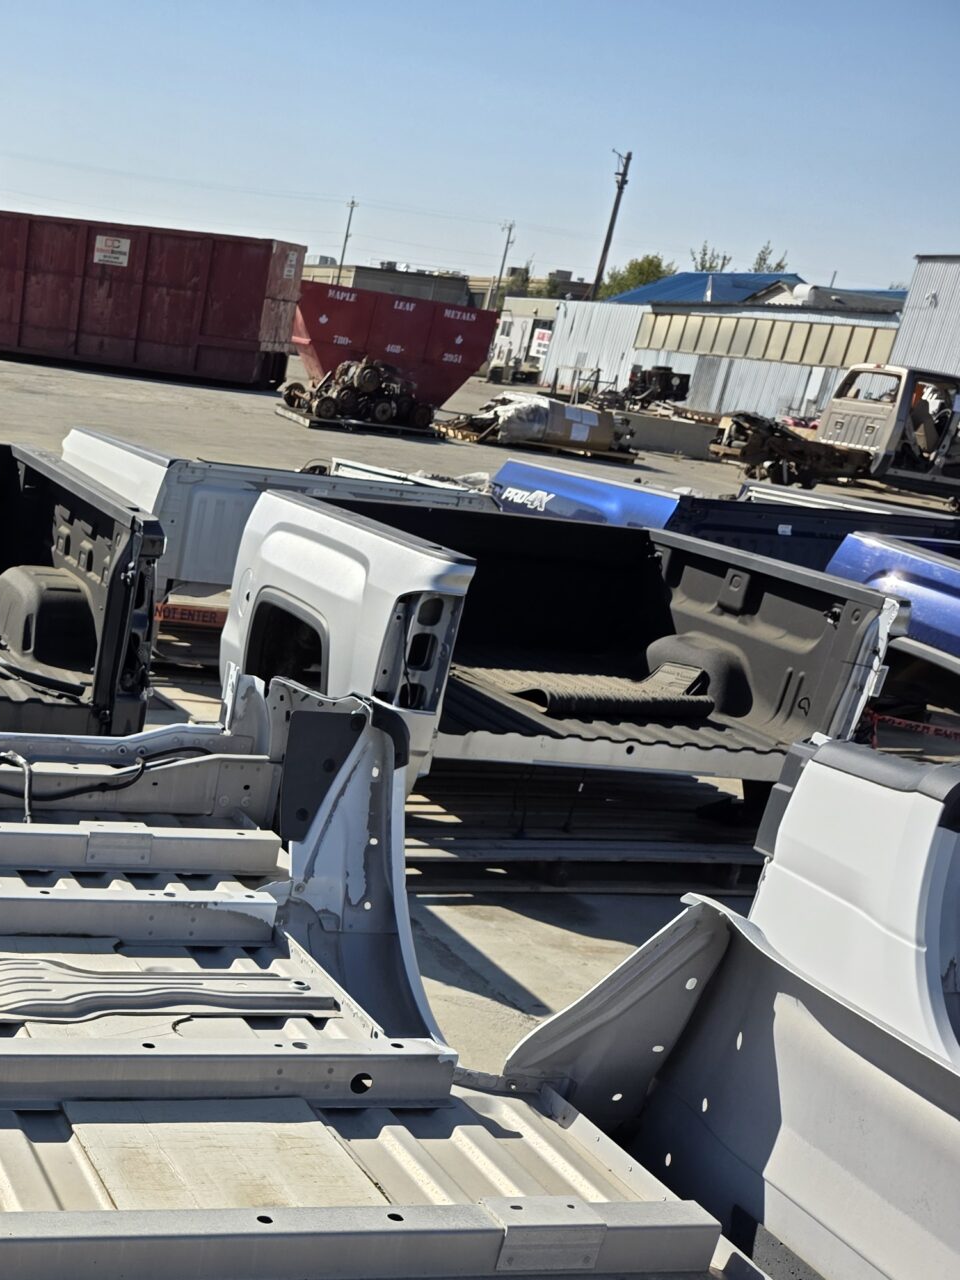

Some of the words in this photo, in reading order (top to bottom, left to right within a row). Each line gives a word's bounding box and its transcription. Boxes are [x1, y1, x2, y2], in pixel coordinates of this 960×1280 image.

[328, 289, 357, 301] MAPLE
[394, 301, 416, 312] LEAF
[444, 309, 477, 321] METALS
[154, 605, 178, 620] NOT
[180, 608, 217, 623] ENTER
